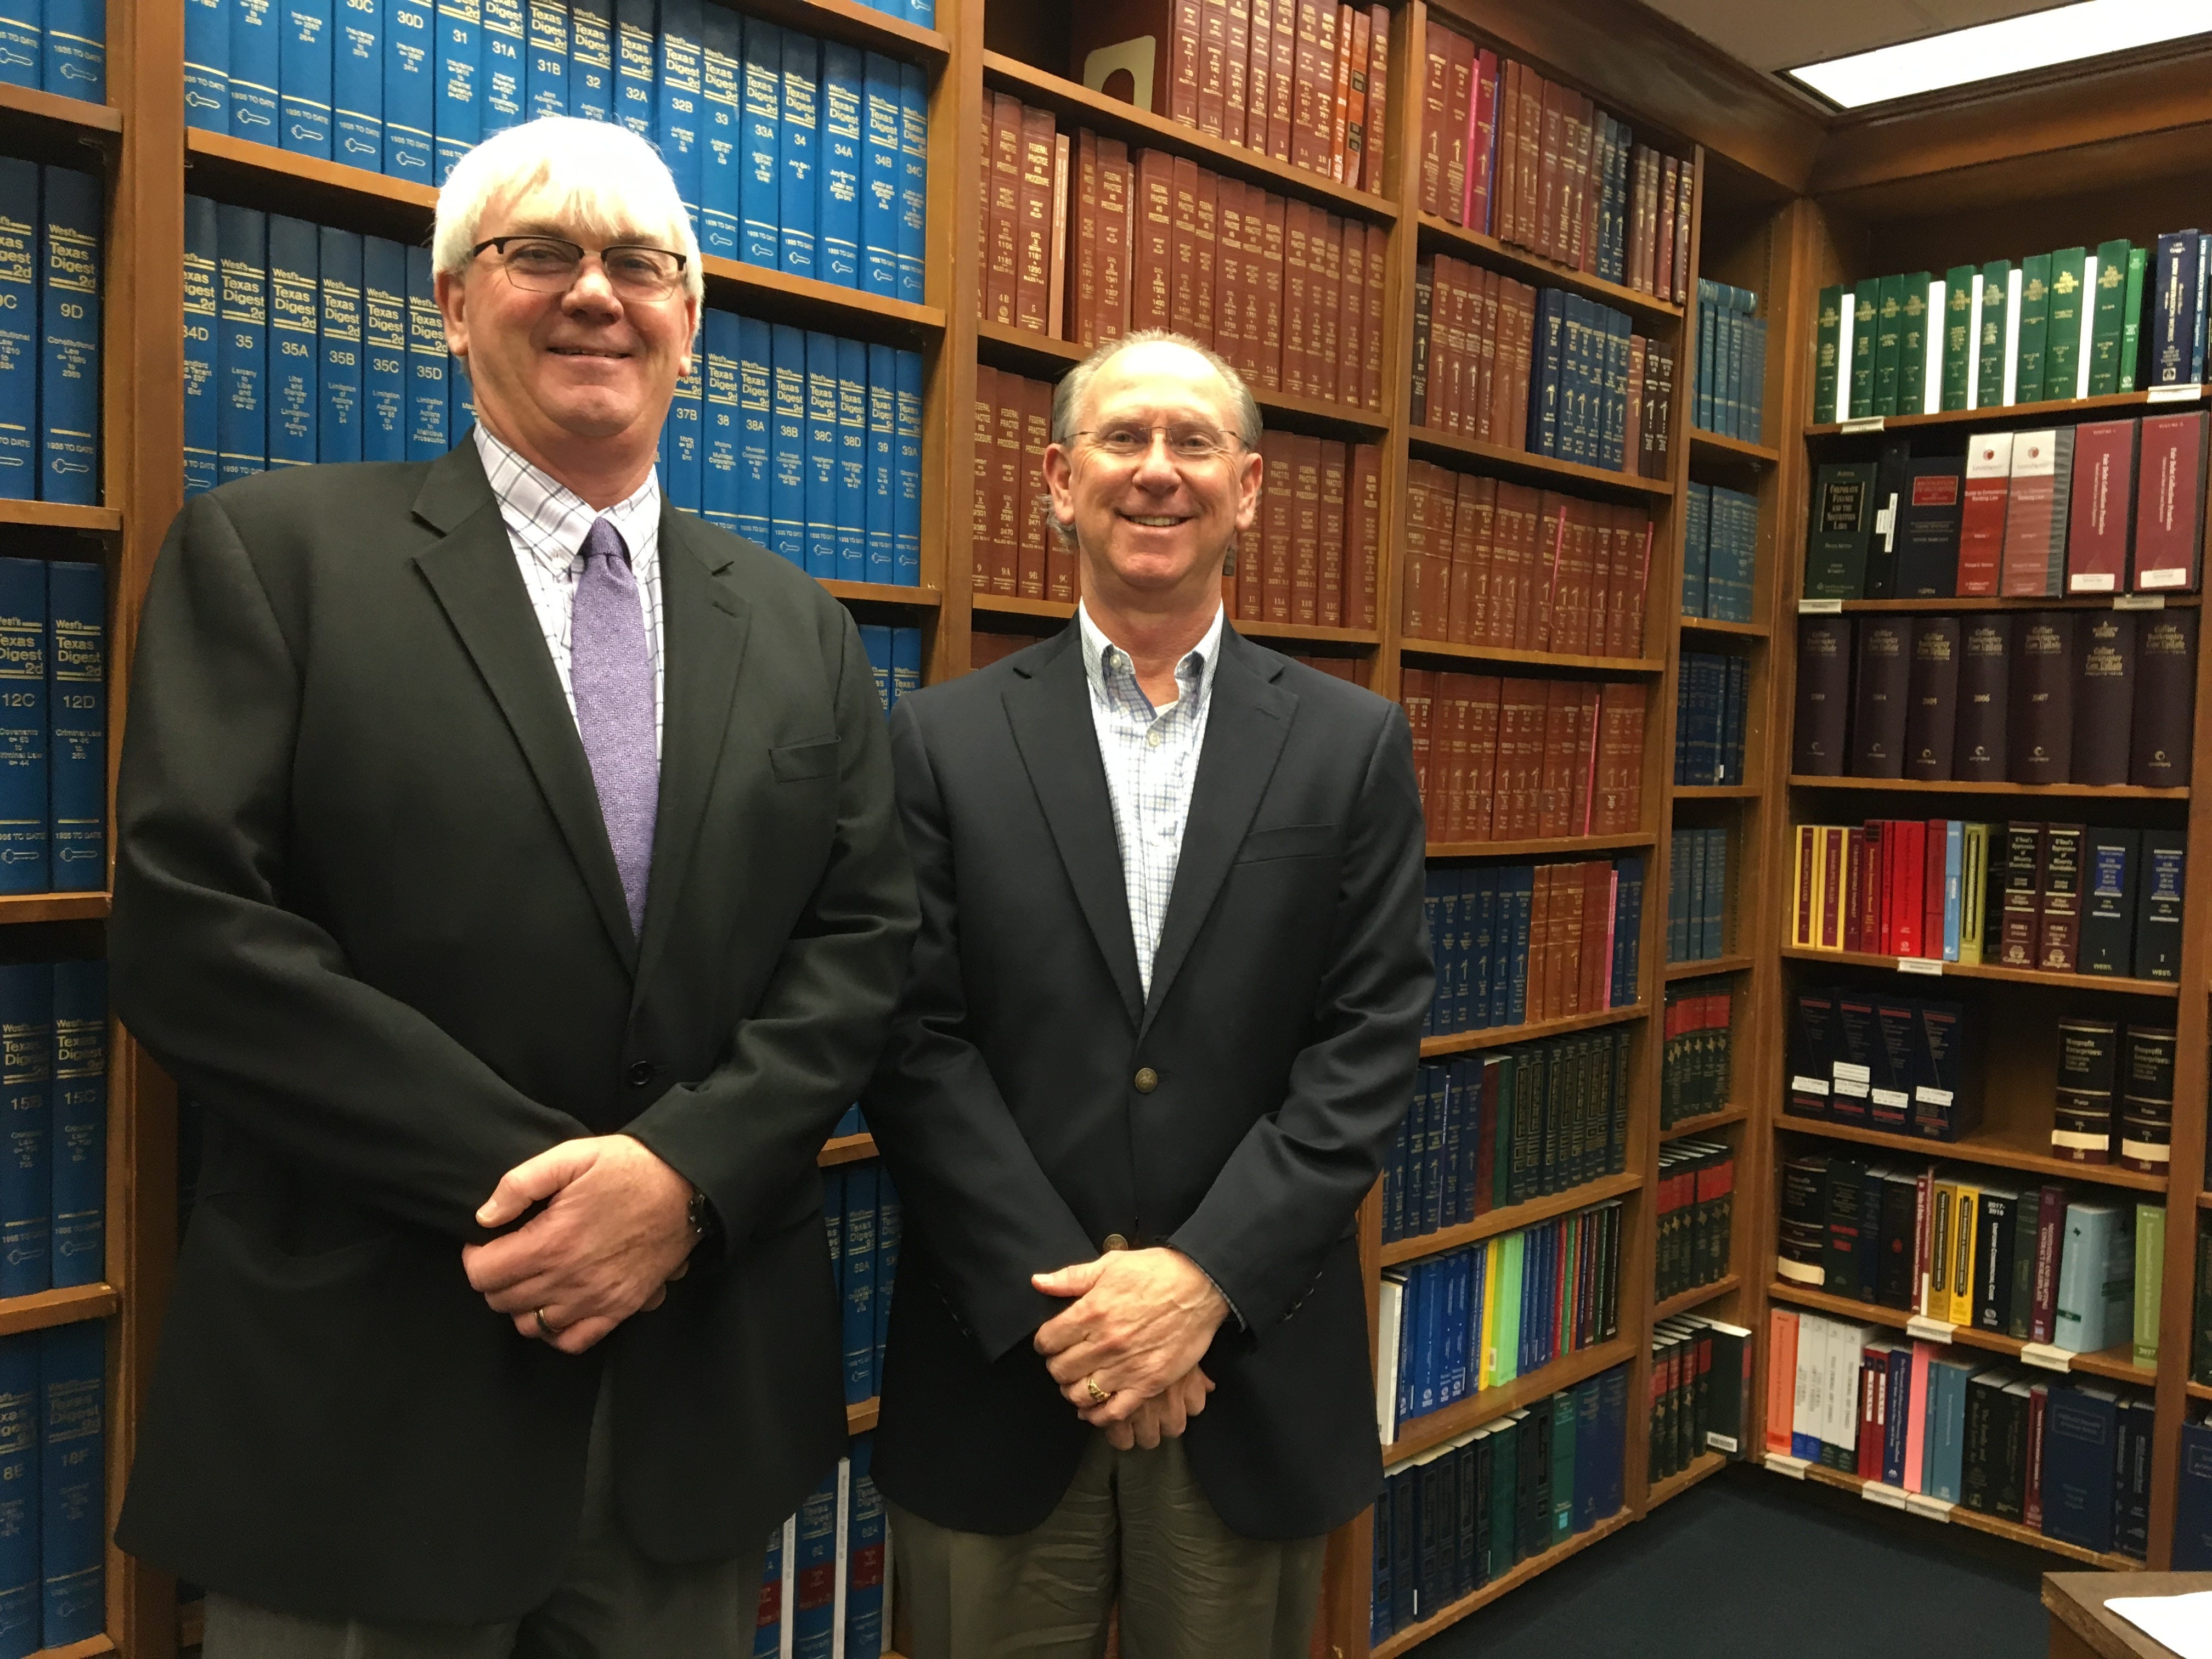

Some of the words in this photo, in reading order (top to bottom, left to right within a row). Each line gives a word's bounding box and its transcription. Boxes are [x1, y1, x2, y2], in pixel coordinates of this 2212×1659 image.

[465, 5, 479, 18] 2d
[486, 3, 523, 22] Digest
[531, 6, 562, 25] Texas
[397, 10, 424, 29] 30D
[510, 21, 523, 34] 2d
[532, 19, 566, 37] Digest
[574, 22, 606, 41] Texas
[453, 30, 467, 44] 31
[664, 33, 686, 44] West's
[493, 41, 516, 59] 31A
[575, 35, 610, 54] Digest
[621, 36, 648, 54] Texas
[597, 52, 610, 65] 2d
[622, 49, 652, 66] Digest
[665, 47, 695, 65] Texas
[538, 59, 560, 75] 31B
[665, 59, 700, 77] Digest
[704, 61, 732, 80] Texas
[586, 75, 600, 88] 32
[687, 77, 700, 89] 2d
[705, 73, 737, 92] Digest
[626, 86, 648, 103] 32A
[672, 98, 693, 113] 32B
[829, 98, 855, 114] Texas
[715, 112, 729, 125] 33
[830, 109, 859, 125] Digest
[870, 108, 894, 125] Texas
[755, 125, 774, 139] 33A
[848, 123, 859, 136] 2d
[870, 119, 897, 136] Digest
[794, 134, 806, 146] 34
[1255, 133, 1263, 143] 2A
[1280, 140, 1284, 149] 3
[835, 144, 853, 158] 34A
[1029, 142, 1048, 155] FEDERAL
[875, 154, 892, 168] 34B
[1028, 153, 1048, 166] PRACTICE
[1334, 154, 1342, 164] 3C
[906, 164, 923, 178] 34C
[1025, 173, 1049, 187] PROCEDURE
[49, 224, 77, 238] West's
[50, 242, 89, 261] Texas
[51, 256, 95, 275] Digest
[221, 259, 248, 271] West's
[1028, 264, 1042, 274] 1290
[273, 268, 299, 281] West's
[79, 275, 95, 288] 2d
[222, 275, 259, 292] Texas
[323, 278, 345, 290] West's
[223, 289, 264, 307] Digest
[274, 284, 309, 302] Texas
[998, 294, 1009, 303] 4B
[275, 297, 315, 315] Digest
[324, 295, 355, 311] Texas
[1031, 305, 1036, 313] 5
[61, 303, 83, 319] 9D
[251, 307, 265, 319] 2d
[325, 308, 360, 325] Digest
[368, 303, 398, 320] Texas
[302, 317, 316, 328] 2d
[369, 317, 403, 333] Digest
[410, 312, 442, 328] Texas
[1107, 326, 1116, 335] 5B
[235, 334, 253, 348] 35
[392, 334, 404, 345] 2d
[282, 342, 308, 358] 35A
[329, 350, 355, 365] 35B
[708, 353, 726, 363] West's
[1246, 359, 1255, 368] 7A
[374, 359, 399, 373] 35C
[417, 365, 442, 379] 35D
[709, 367, 733, 380] Texas
[709, 377, 737, 392] Digest
[777, 381, 799, 393] Texas
[728, 392, 738, 401] 2d
[777, 391, 803, 404] Digest
[676, 408, 697, 421] 37B
[1001, 408, 1019, 419] FEDERAL
[718, 415, 729, 426] 38
[746, 419, 765, 432] 38A
[1000, 419, 1019, 430] PRACTICE
[1029, 415, 1046, 426] FEDERAL
[781, 426, 798, 438] 38B
[814, 431, 832, 442] 38C
[844, 436, 861, 448] 38D
[878, 442, 888, 452] 39
[997, 438, 1020, 450] PROCEDURE
[902, 445, 918, 457] 39A
[1272, 461, 1288, 470] FEDERAL
[1270, 470, 1289, 479] PRACTICE
[1268, 487, 1291, 496] PROCEDURE
[1001, 528, 1013, 536] 2470
[1001, 567, 1011, 576] 9A
[1029, 571, 1037, 579] 9B
[1059, 574, 1067, 583] 9C
[56, 620, 83, 630] West's
[57, 636, 94, 650] Texas
[58, 651, 101, 663] Digest
[894, 679, 915, 689] Texas
[2, 693, 35, 707] 12C
[63, 695, 95, 709] 12D
[2067, 1037, 2095, 1048] Nonprofit
